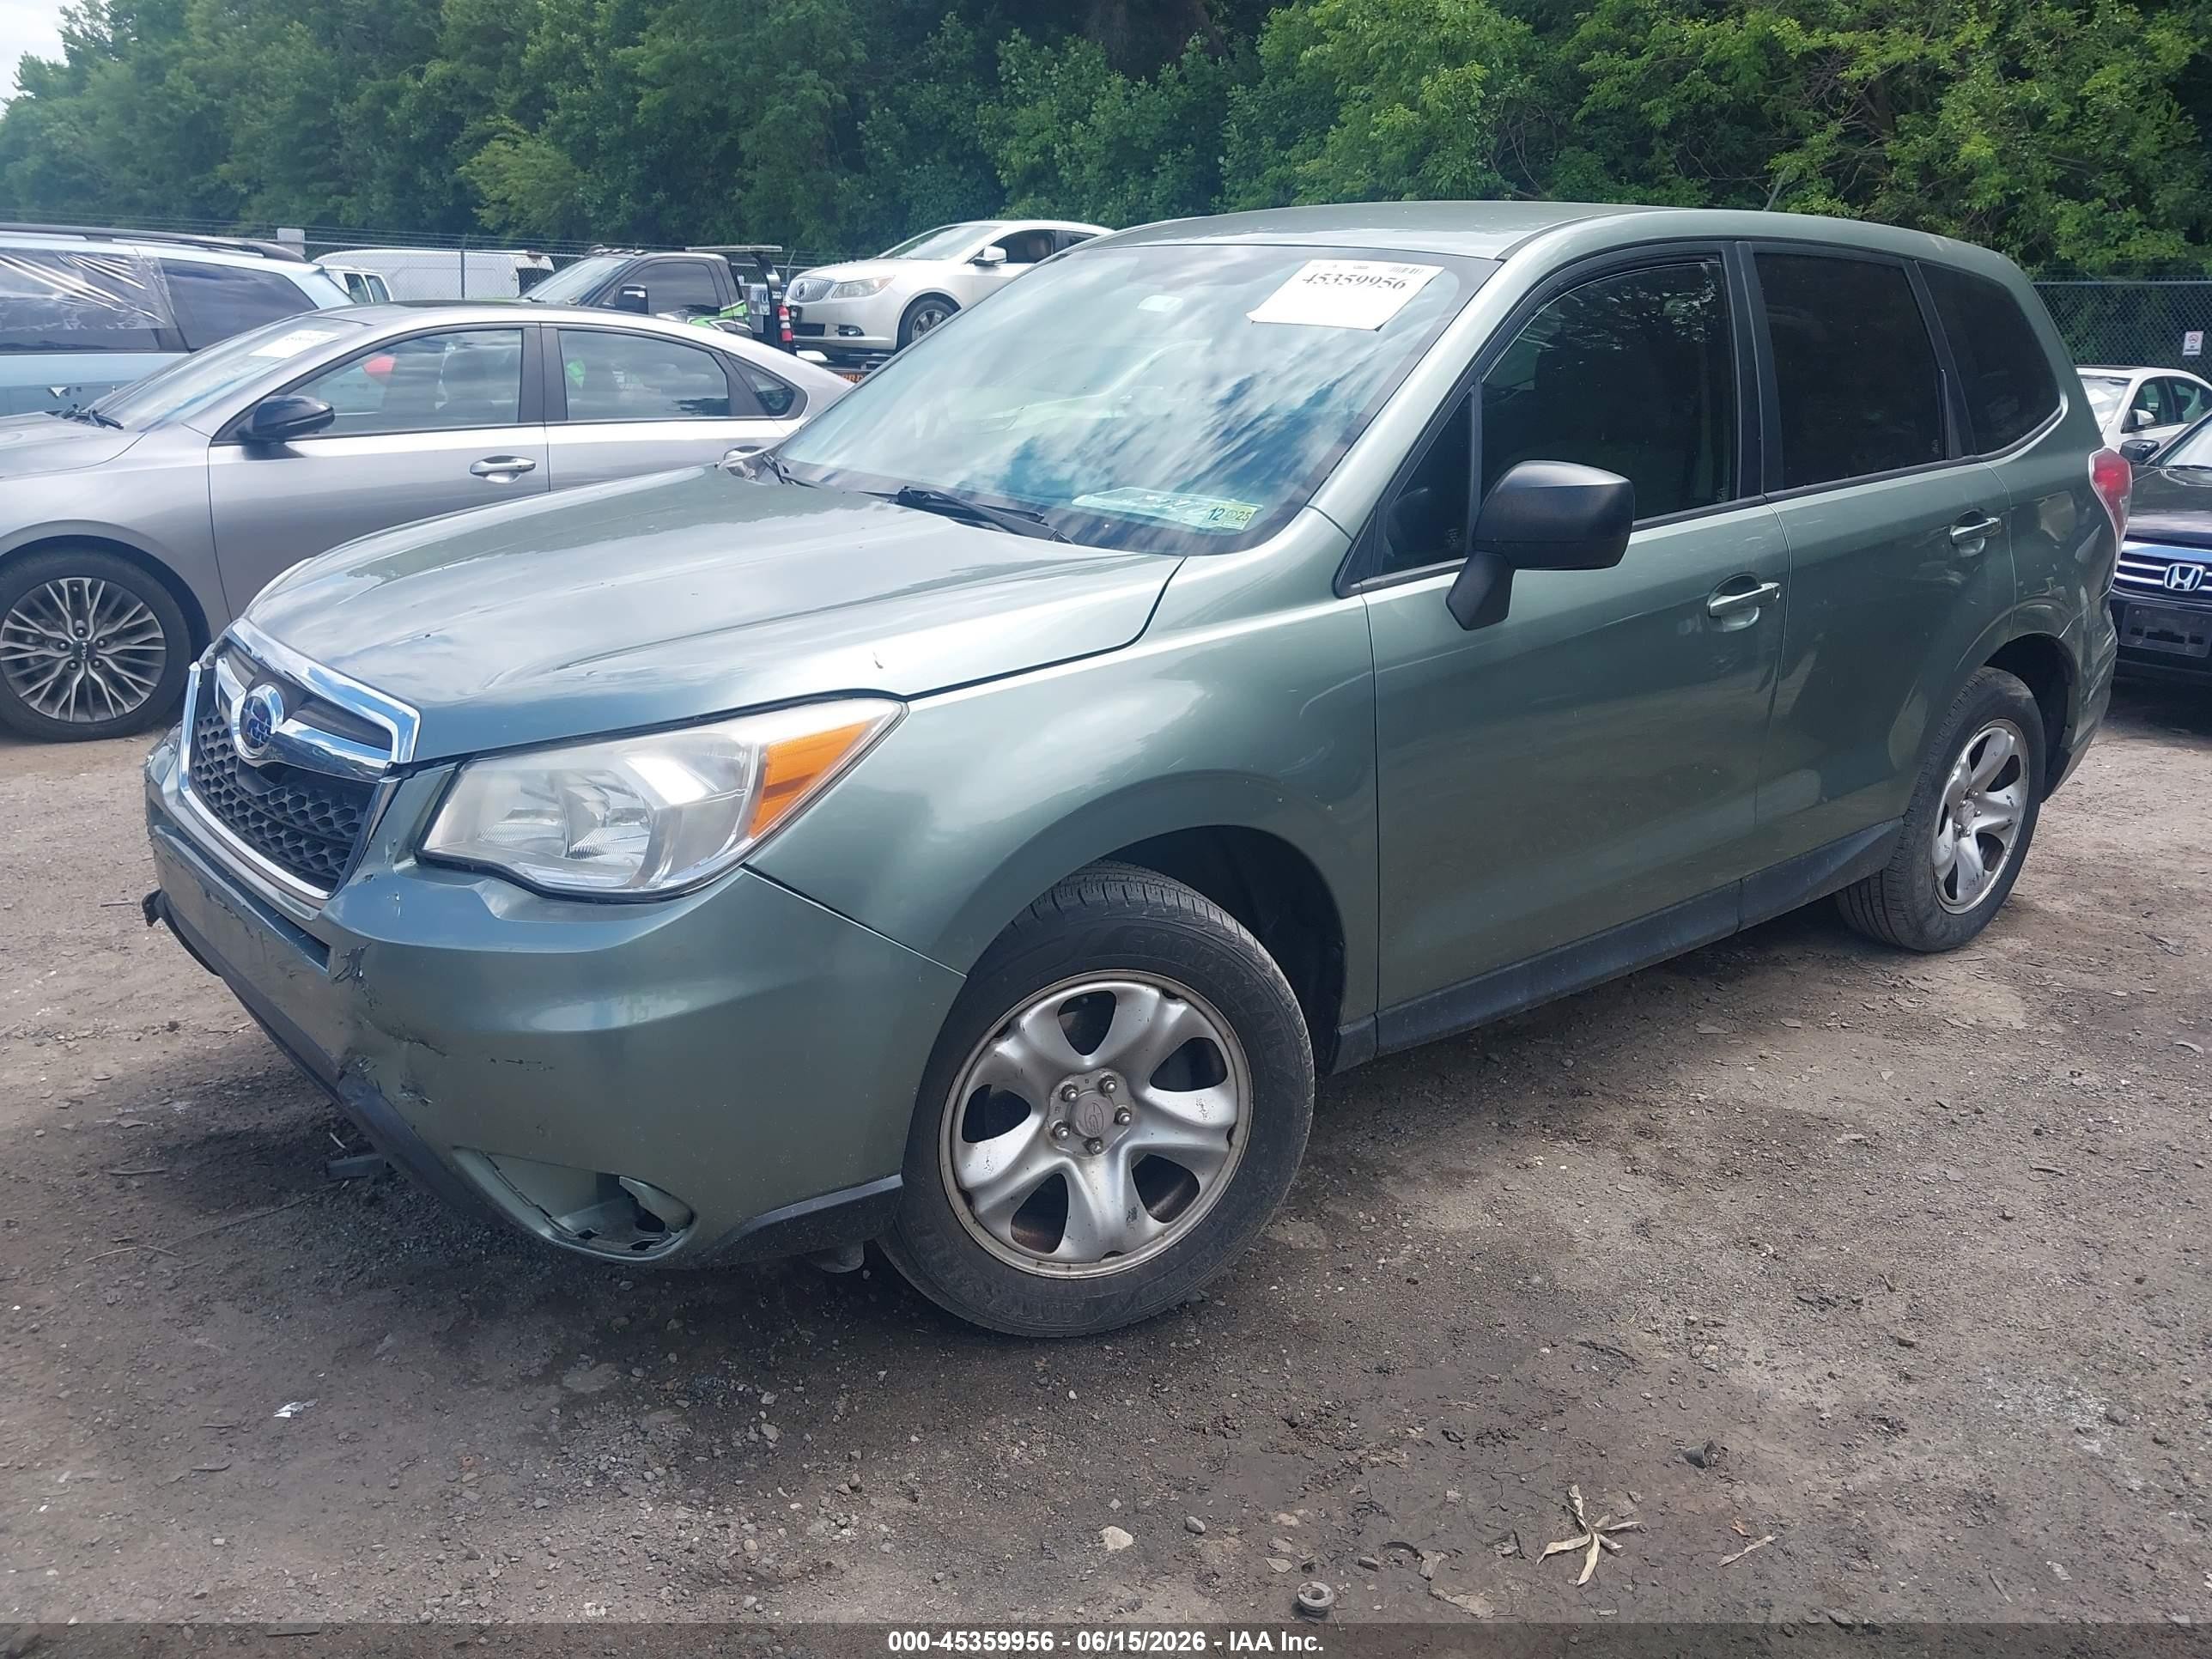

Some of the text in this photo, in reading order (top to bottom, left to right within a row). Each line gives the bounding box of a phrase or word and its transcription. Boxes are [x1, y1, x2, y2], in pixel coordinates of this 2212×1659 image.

[1302, 273, 1408, 289] 45359956
[1208, 507, 1252, 522] 12 25
